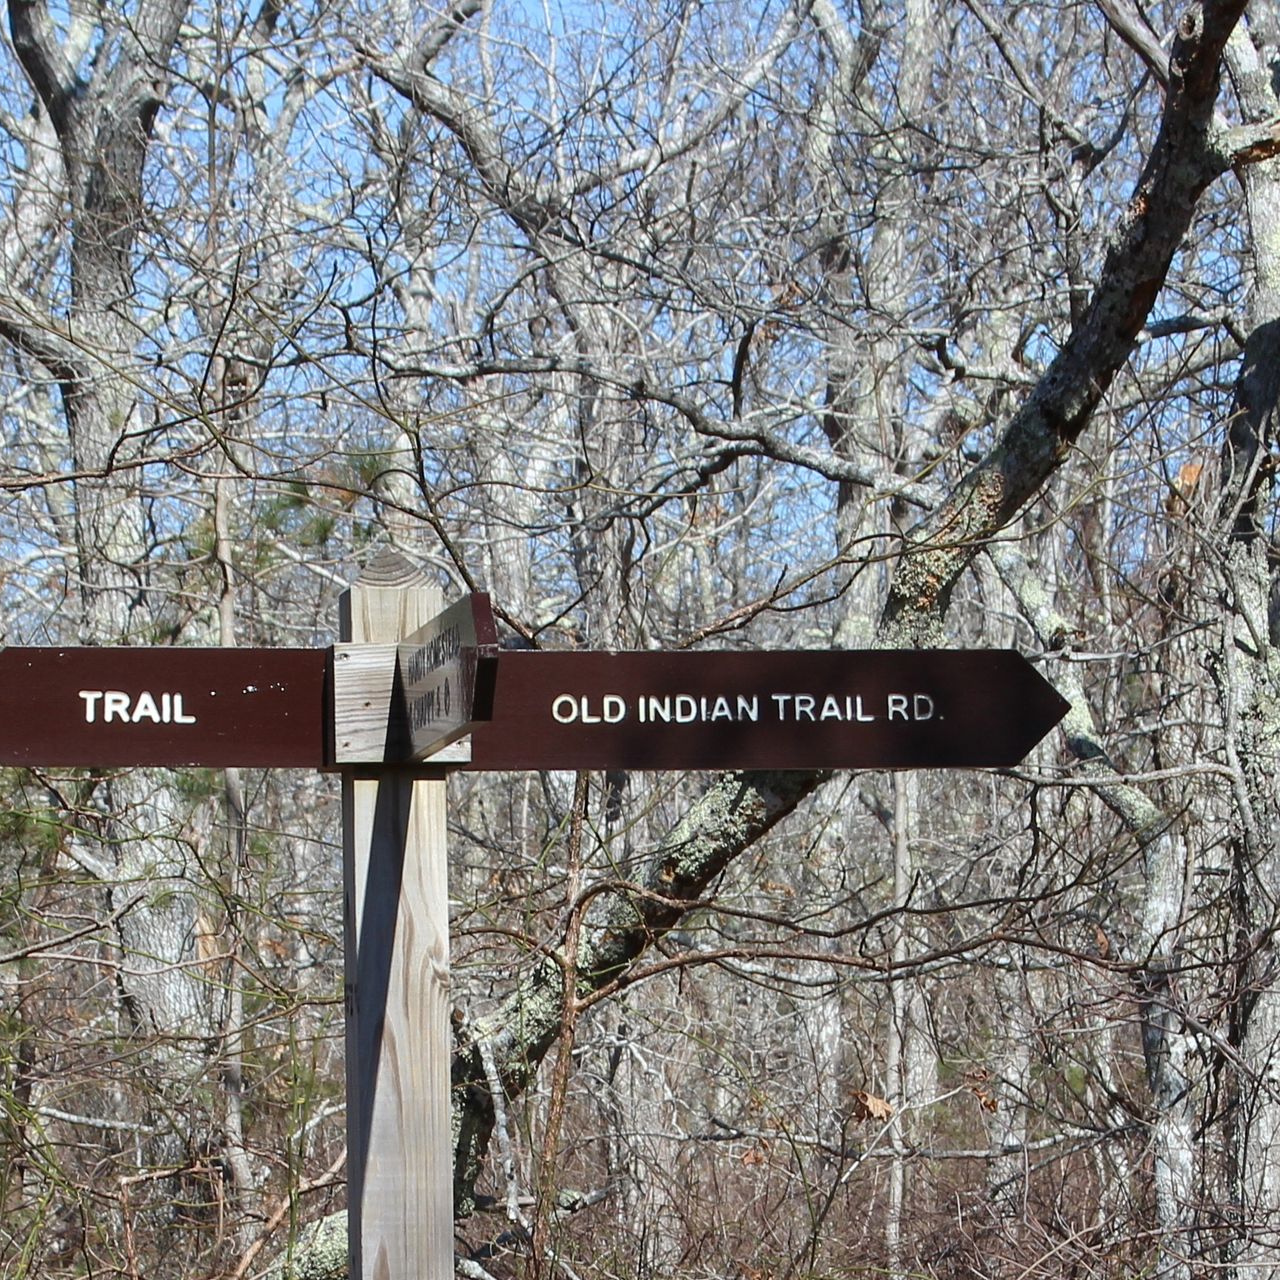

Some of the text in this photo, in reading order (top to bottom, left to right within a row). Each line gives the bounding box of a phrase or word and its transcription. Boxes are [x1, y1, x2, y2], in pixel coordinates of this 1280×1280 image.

[78, 690, 197, 724] TRAIL
[552, 693, 945, 724] OLD INDIAN TRAIL RD.
